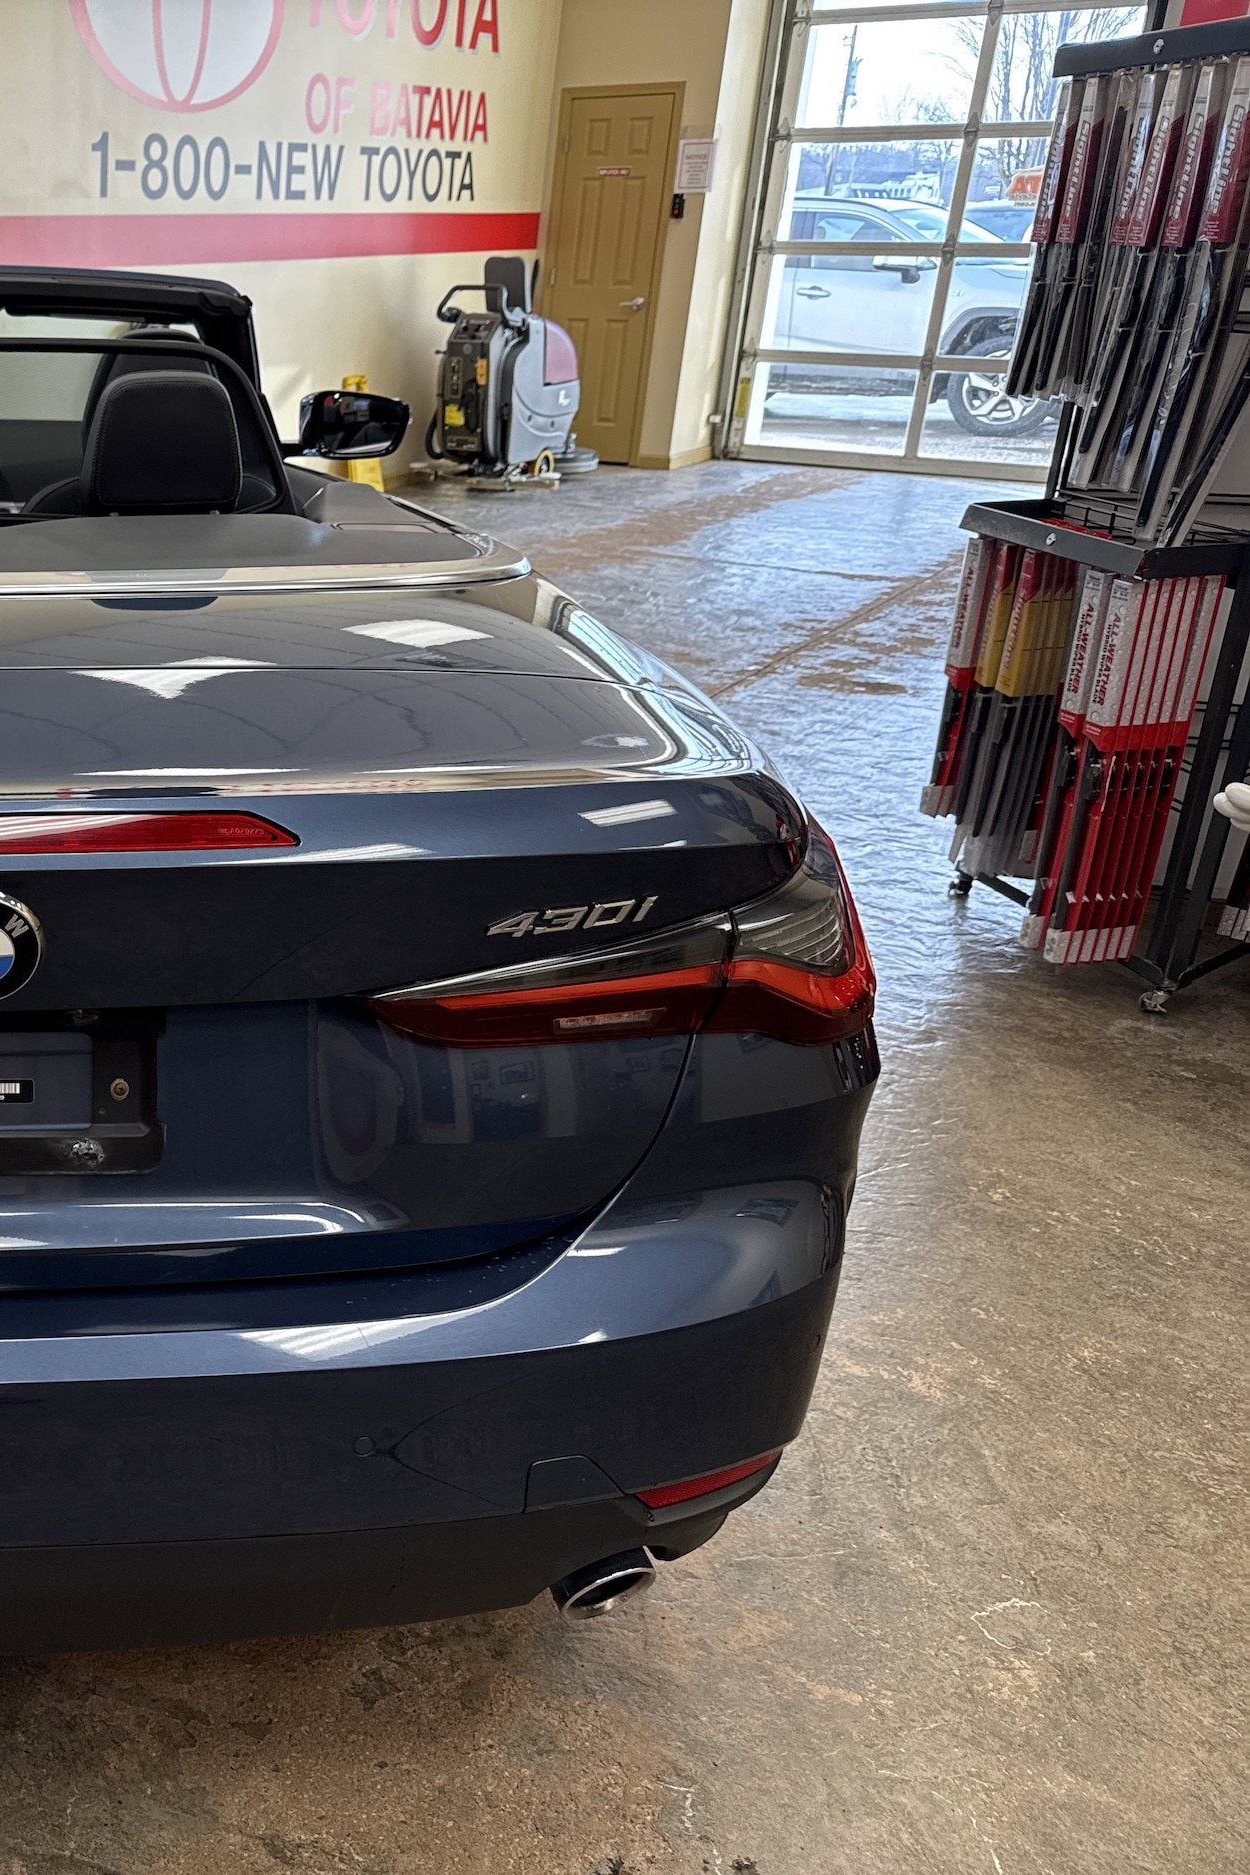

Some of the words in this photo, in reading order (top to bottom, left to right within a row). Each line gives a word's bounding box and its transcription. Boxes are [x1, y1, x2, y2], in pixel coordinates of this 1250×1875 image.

[305, 72, 356, 136] OF
[369, 80, 489, 143] BATAVIA
[91, 131, 346, 201] 1-800-NEW
[360, 145, 475, 202] TOYOTA
[1072, 603, 1095, 695] ALL-WEATHER
[1097, 613, 1121, 706] ALL-WEATHER
